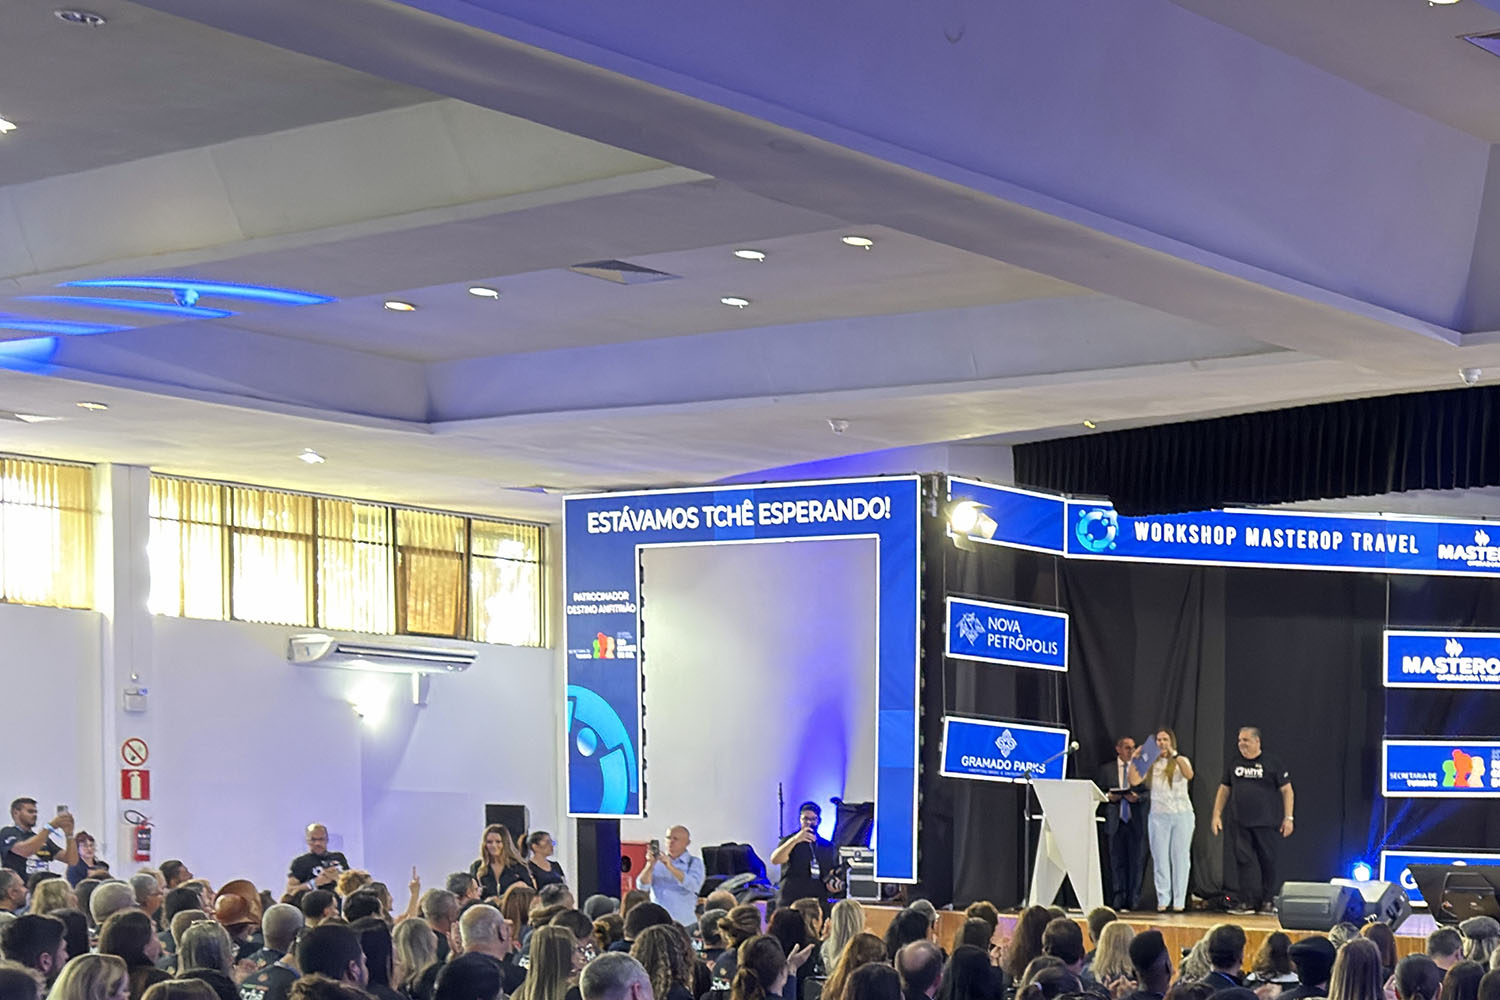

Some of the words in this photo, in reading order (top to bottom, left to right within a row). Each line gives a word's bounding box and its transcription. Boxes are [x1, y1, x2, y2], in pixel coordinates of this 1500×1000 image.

[587, 504, 699, 534] ESTÁVAMOS
[702, 499, 754, 528] TCHÊ
[758, 496, 891, 526] ESPERANDO!
[1134, 521, 1237, 546] WORKSHOP
[1245, 528, 1343, 551] MASTEROP
[1351, 532, 1419, 554] TRAVEL
[987, 616, 1021, 634] NOVA
[987, 633, 1058, 656] PETRÓPOLIS
[961, 755, 1012, 771] GRAMADO
[1013, 760, 1046, 774] PARKS
